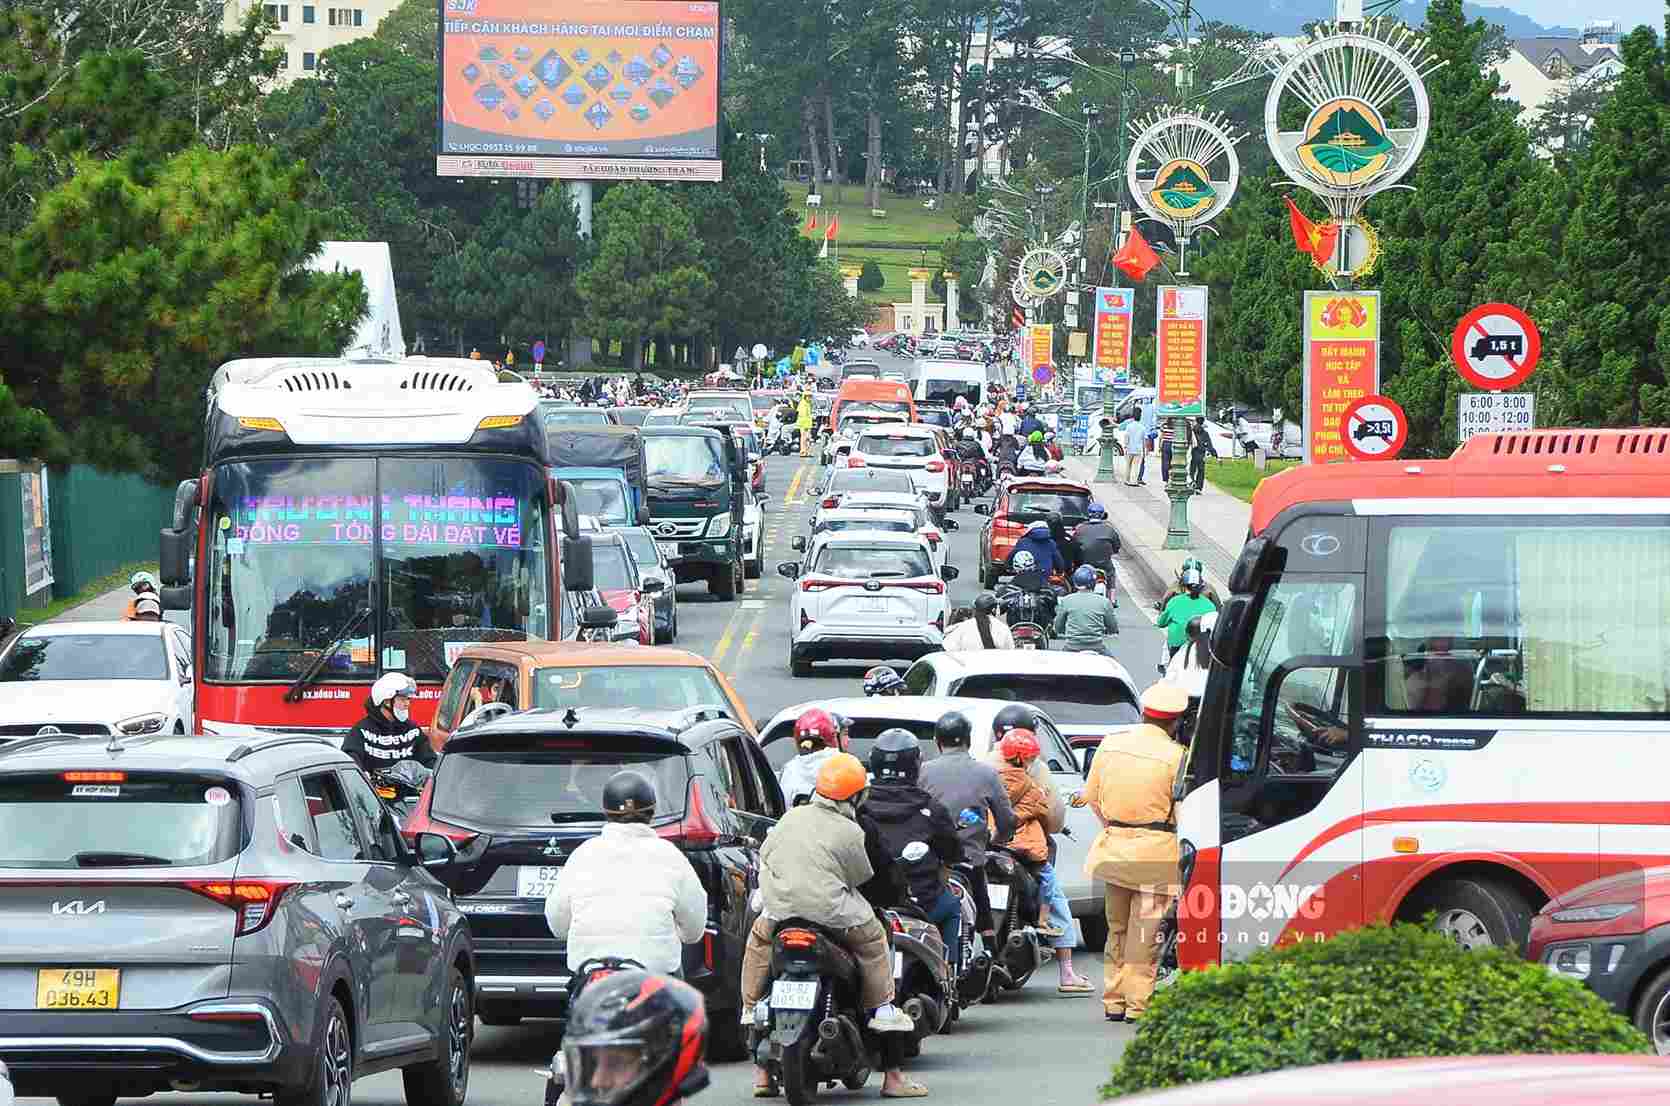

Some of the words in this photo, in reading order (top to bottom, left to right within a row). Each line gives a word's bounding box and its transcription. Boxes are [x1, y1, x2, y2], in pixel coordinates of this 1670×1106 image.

[503, 17, 546, 34] KHÁCH
[1470, 396, 1493, 408] 6:00
[1503, 396, 1526, 408] 8:00
[1463, 411, 1491, 423] 10:00
[1502, 411, 1529, 423] 12:00
[1368, 734, 1432, 745] THACO
[52, 901, 105, 914] KIA
[62, 970, 96, 987] 49H
